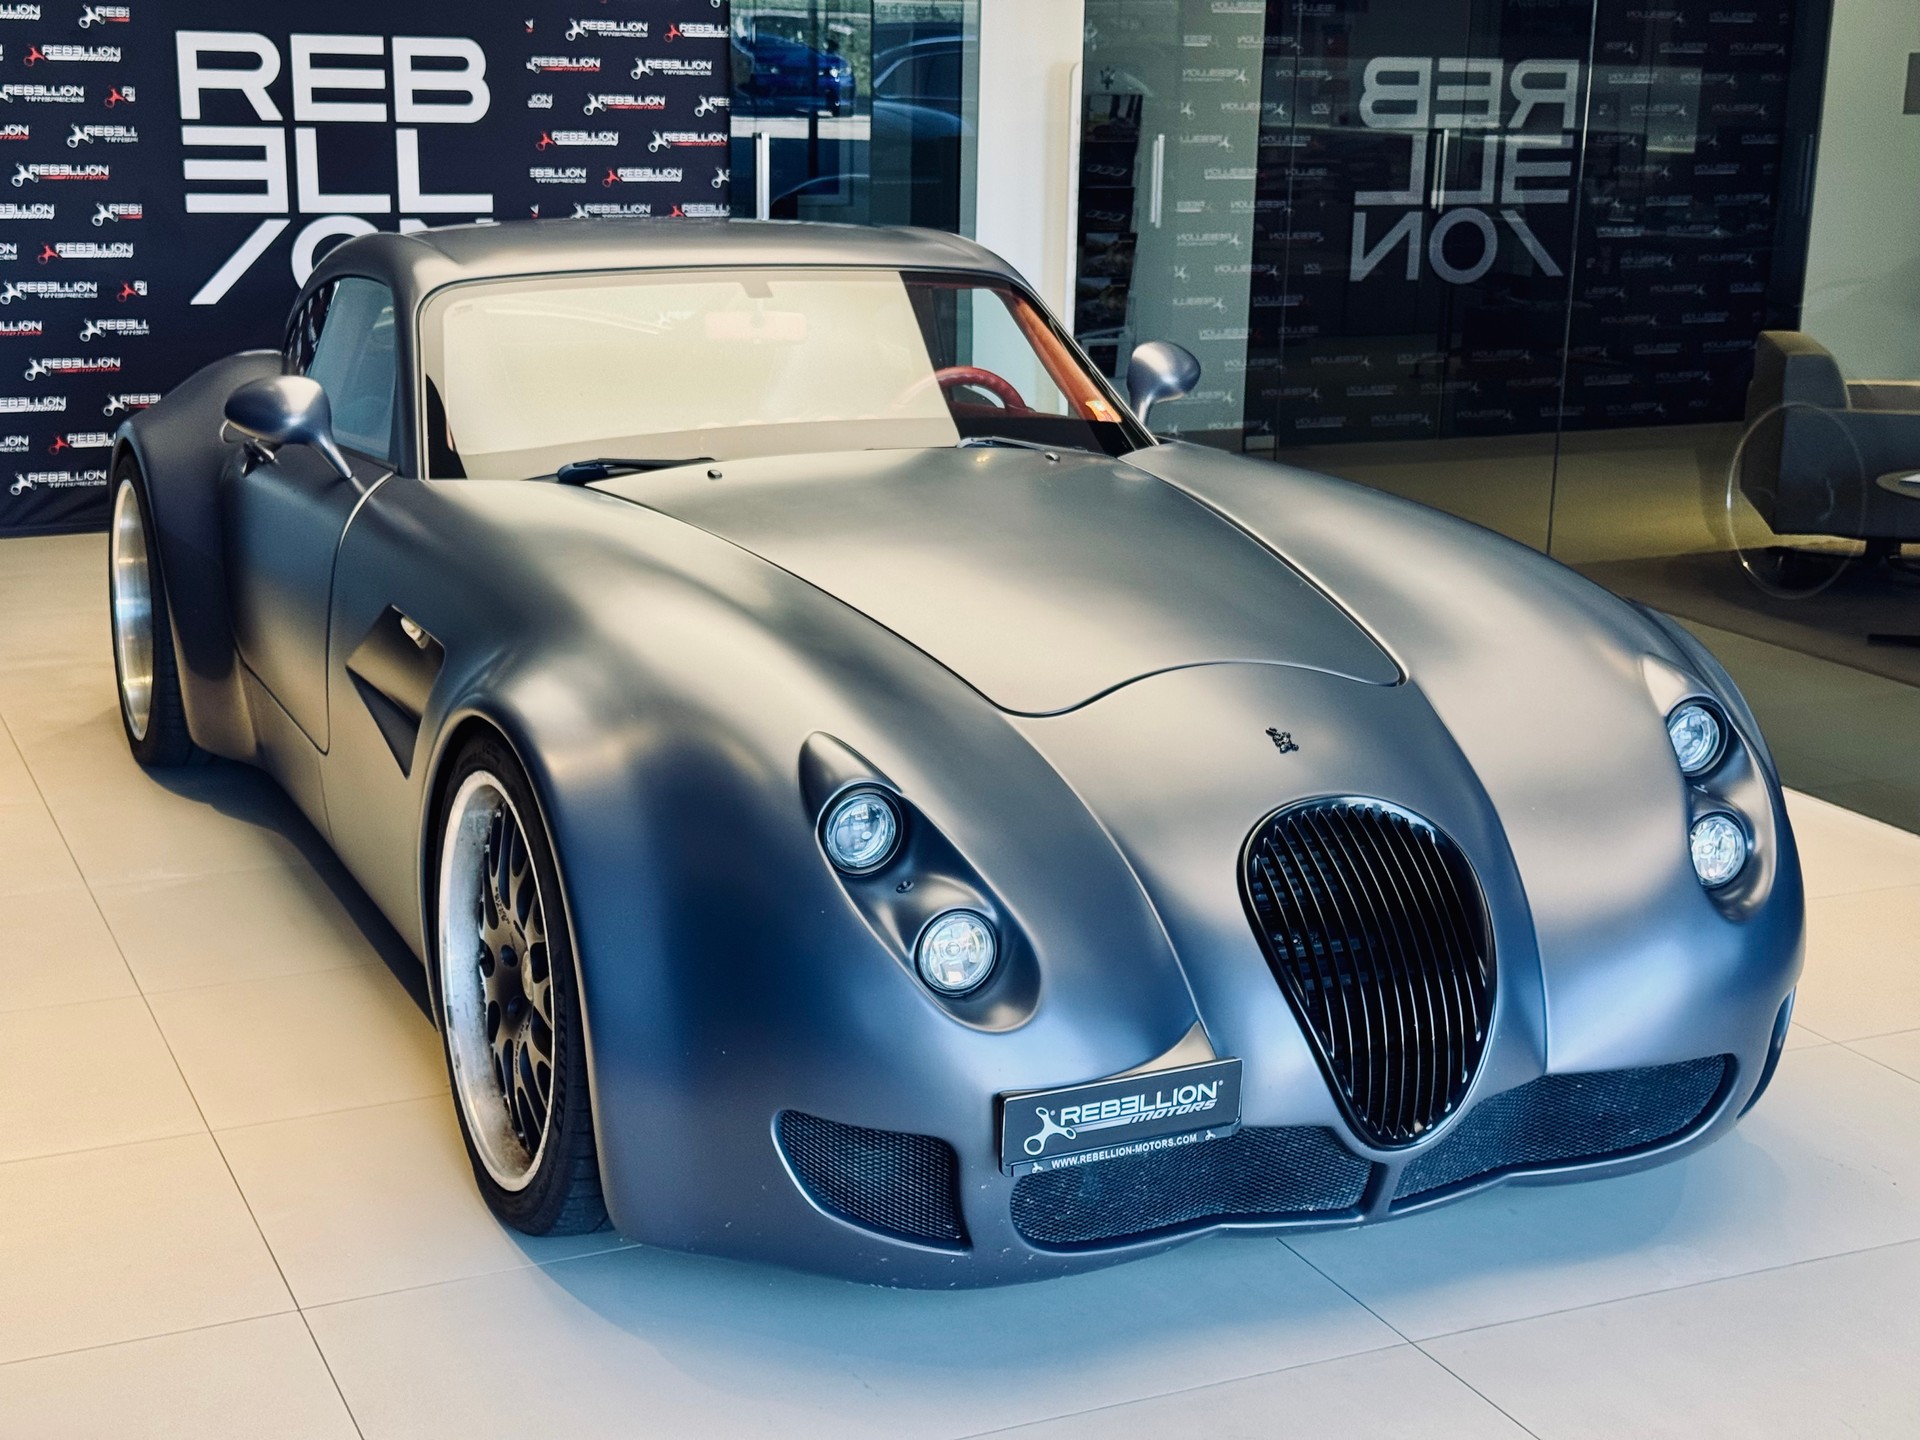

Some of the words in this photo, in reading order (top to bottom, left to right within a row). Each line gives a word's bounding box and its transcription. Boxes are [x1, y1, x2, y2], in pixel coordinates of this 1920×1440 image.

[580, 21, 649, 32] REBELLION
[679, 23, 729, 34] REBELL
[42, 45, 121, 57] REBELLION
[531, 56, 601, 67] REBELLION
[645, 59, 712, 70] REBELLION
[176, 30, 491, 124] REB
[3, 85, 84, 96] REBELLION
[598, 95, 665, 106] REBELLION
[552, 131, 619, 142] REBELLION
[662, 132, 728, 143] REBELLION
[29, 164, 109, 176] REBELLION
[617, 168, 683, 178] REBELLION
[584, 203, 651, 214] REBELLION
[681, 204, 730, 214] REBELL
[55, 242, 134, 254] REBELLION
[17, 282, 98, 293] REBELLION
[42, 358, 121, 370] REBELLION
[28, 470, 107, 483] REBELLION
[1060, 1080, 1218, 1127] REBELLION
[1130, 1099, 1218, 1124] MOTORS
[1051, 1133, 1198, 1169] WWW.REBELLION-MOTORS.COM
